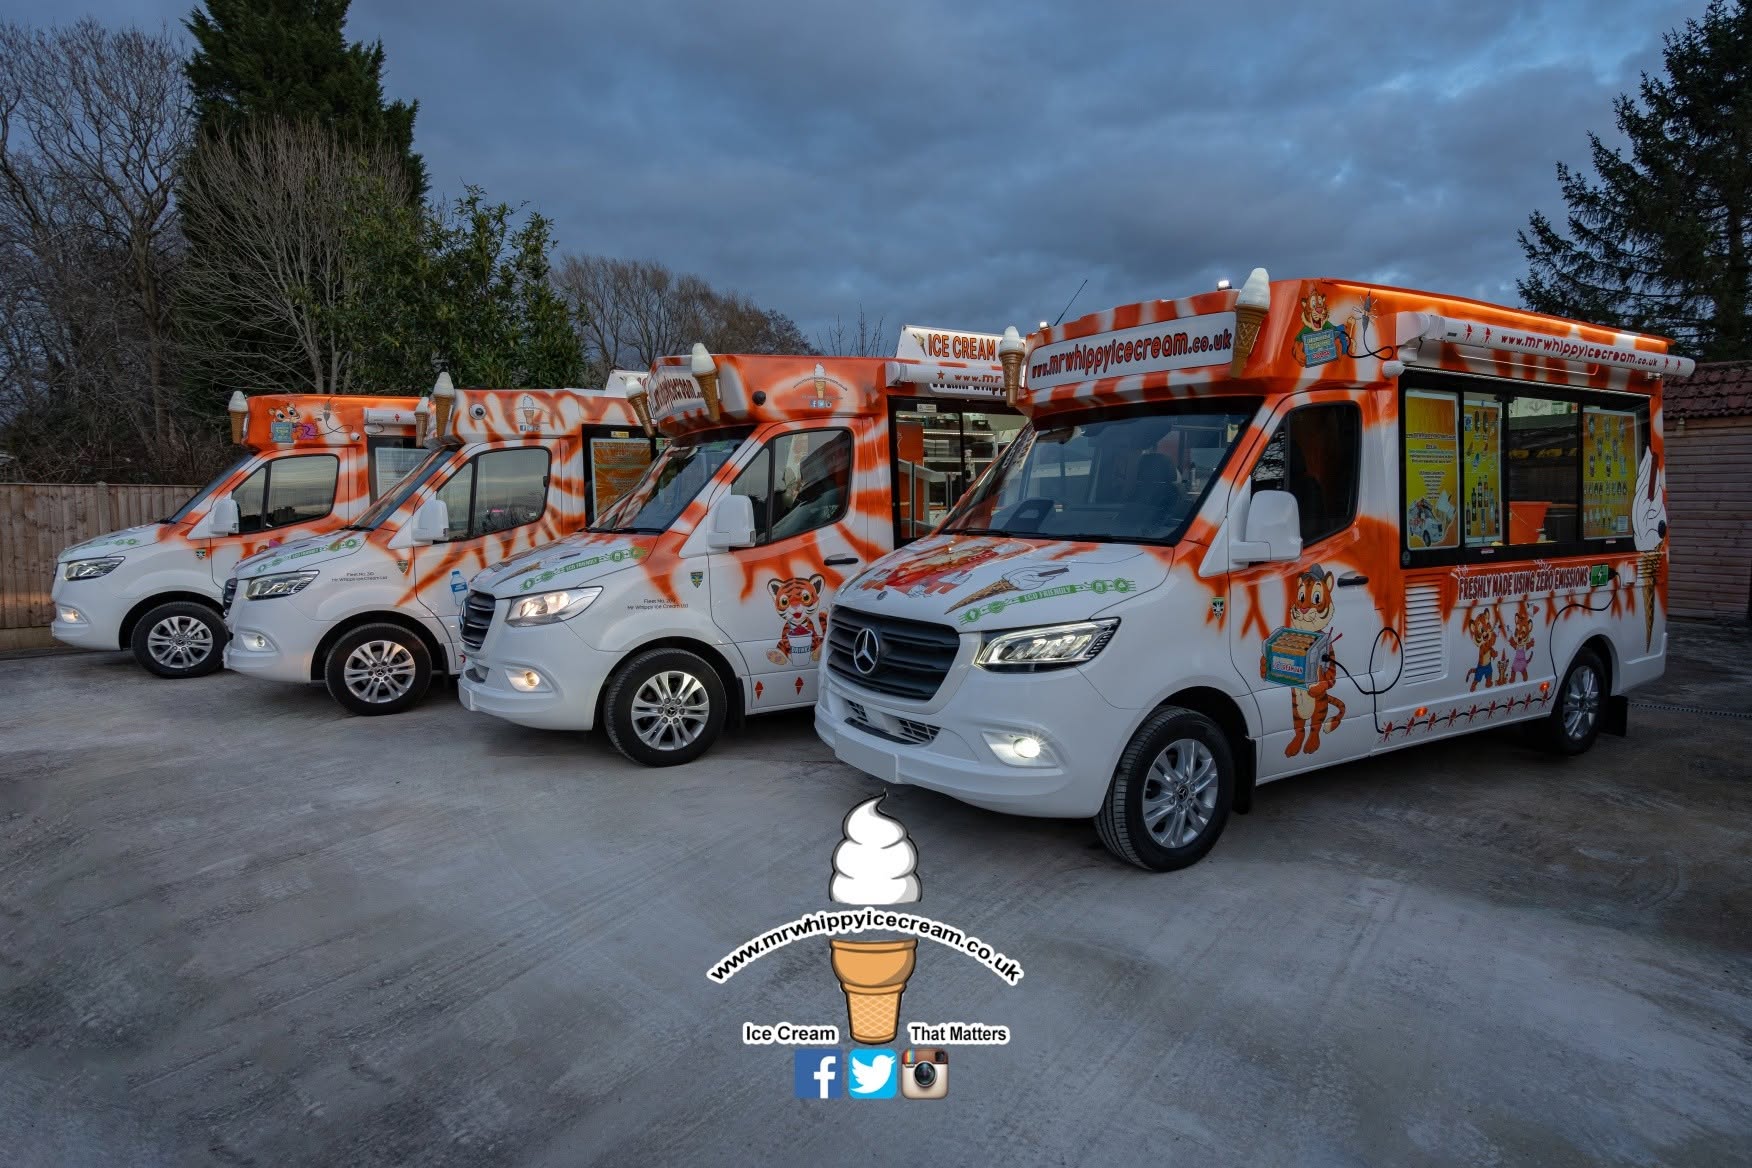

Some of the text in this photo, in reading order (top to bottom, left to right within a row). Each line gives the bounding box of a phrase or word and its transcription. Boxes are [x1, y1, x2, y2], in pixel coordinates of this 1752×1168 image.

[928, 333, 996, 361] ICE CREAM
[1031, 328, 1233, 379] www.mrwhippyicecream.co.uk
[1501, 334, 1658, 367] www.mrwhippyicecream.co.uk
[1024, 585, 1071, 602] ECO FRIENDLY
[1458, 566, 1589, 600] FRESHLY MADE USING ZERO EMISSIONS
